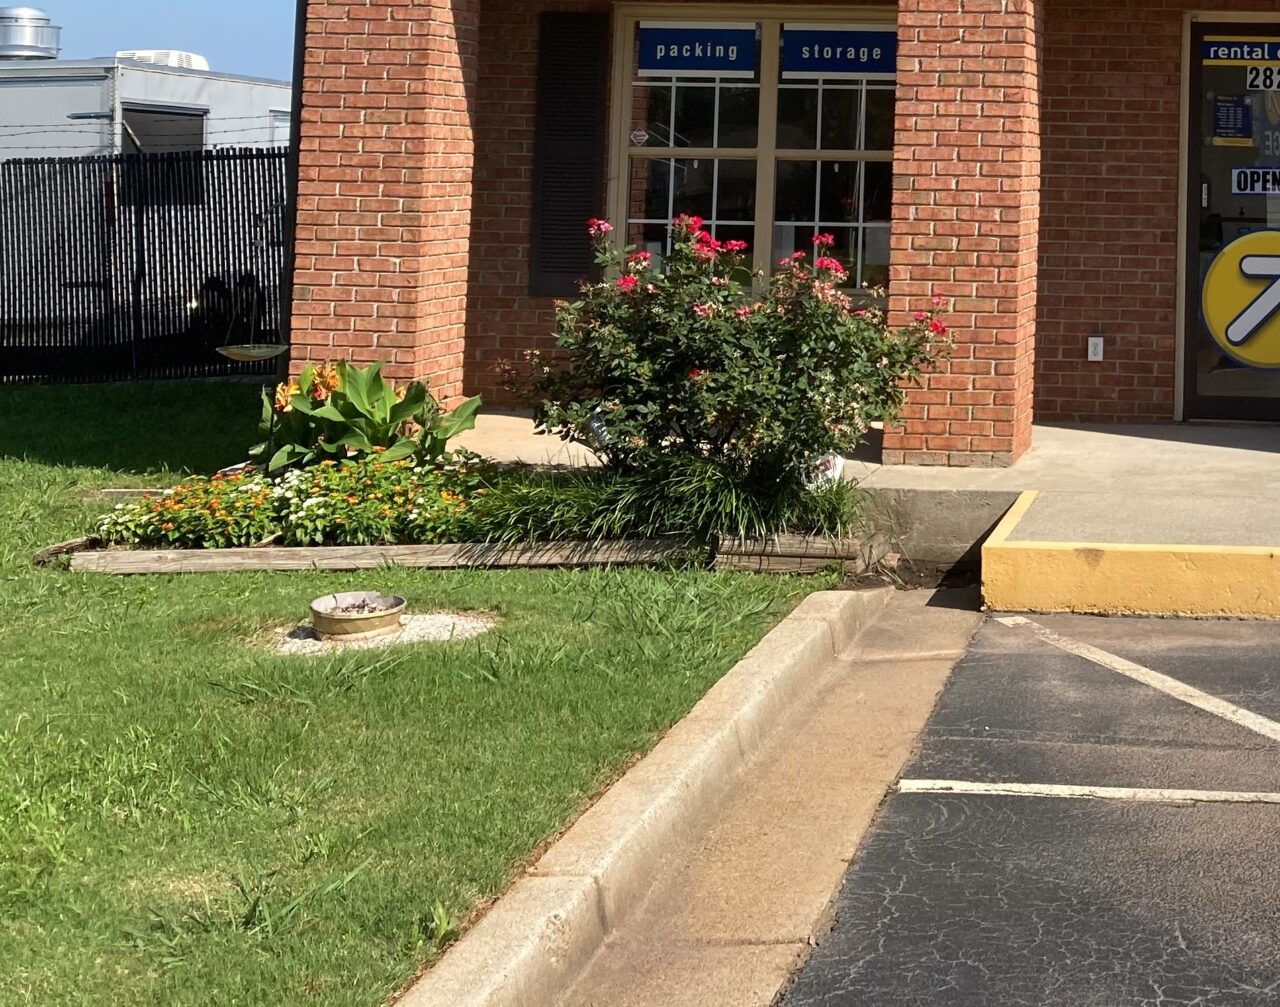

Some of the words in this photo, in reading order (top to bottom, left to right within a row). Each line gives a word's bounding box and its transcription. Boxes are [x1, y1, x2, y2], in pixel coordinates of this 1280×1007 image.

[656, 43, 738, 61] packing
[801, 45, 881, 62] storage
[1210, 44, 1270, 59] rental
